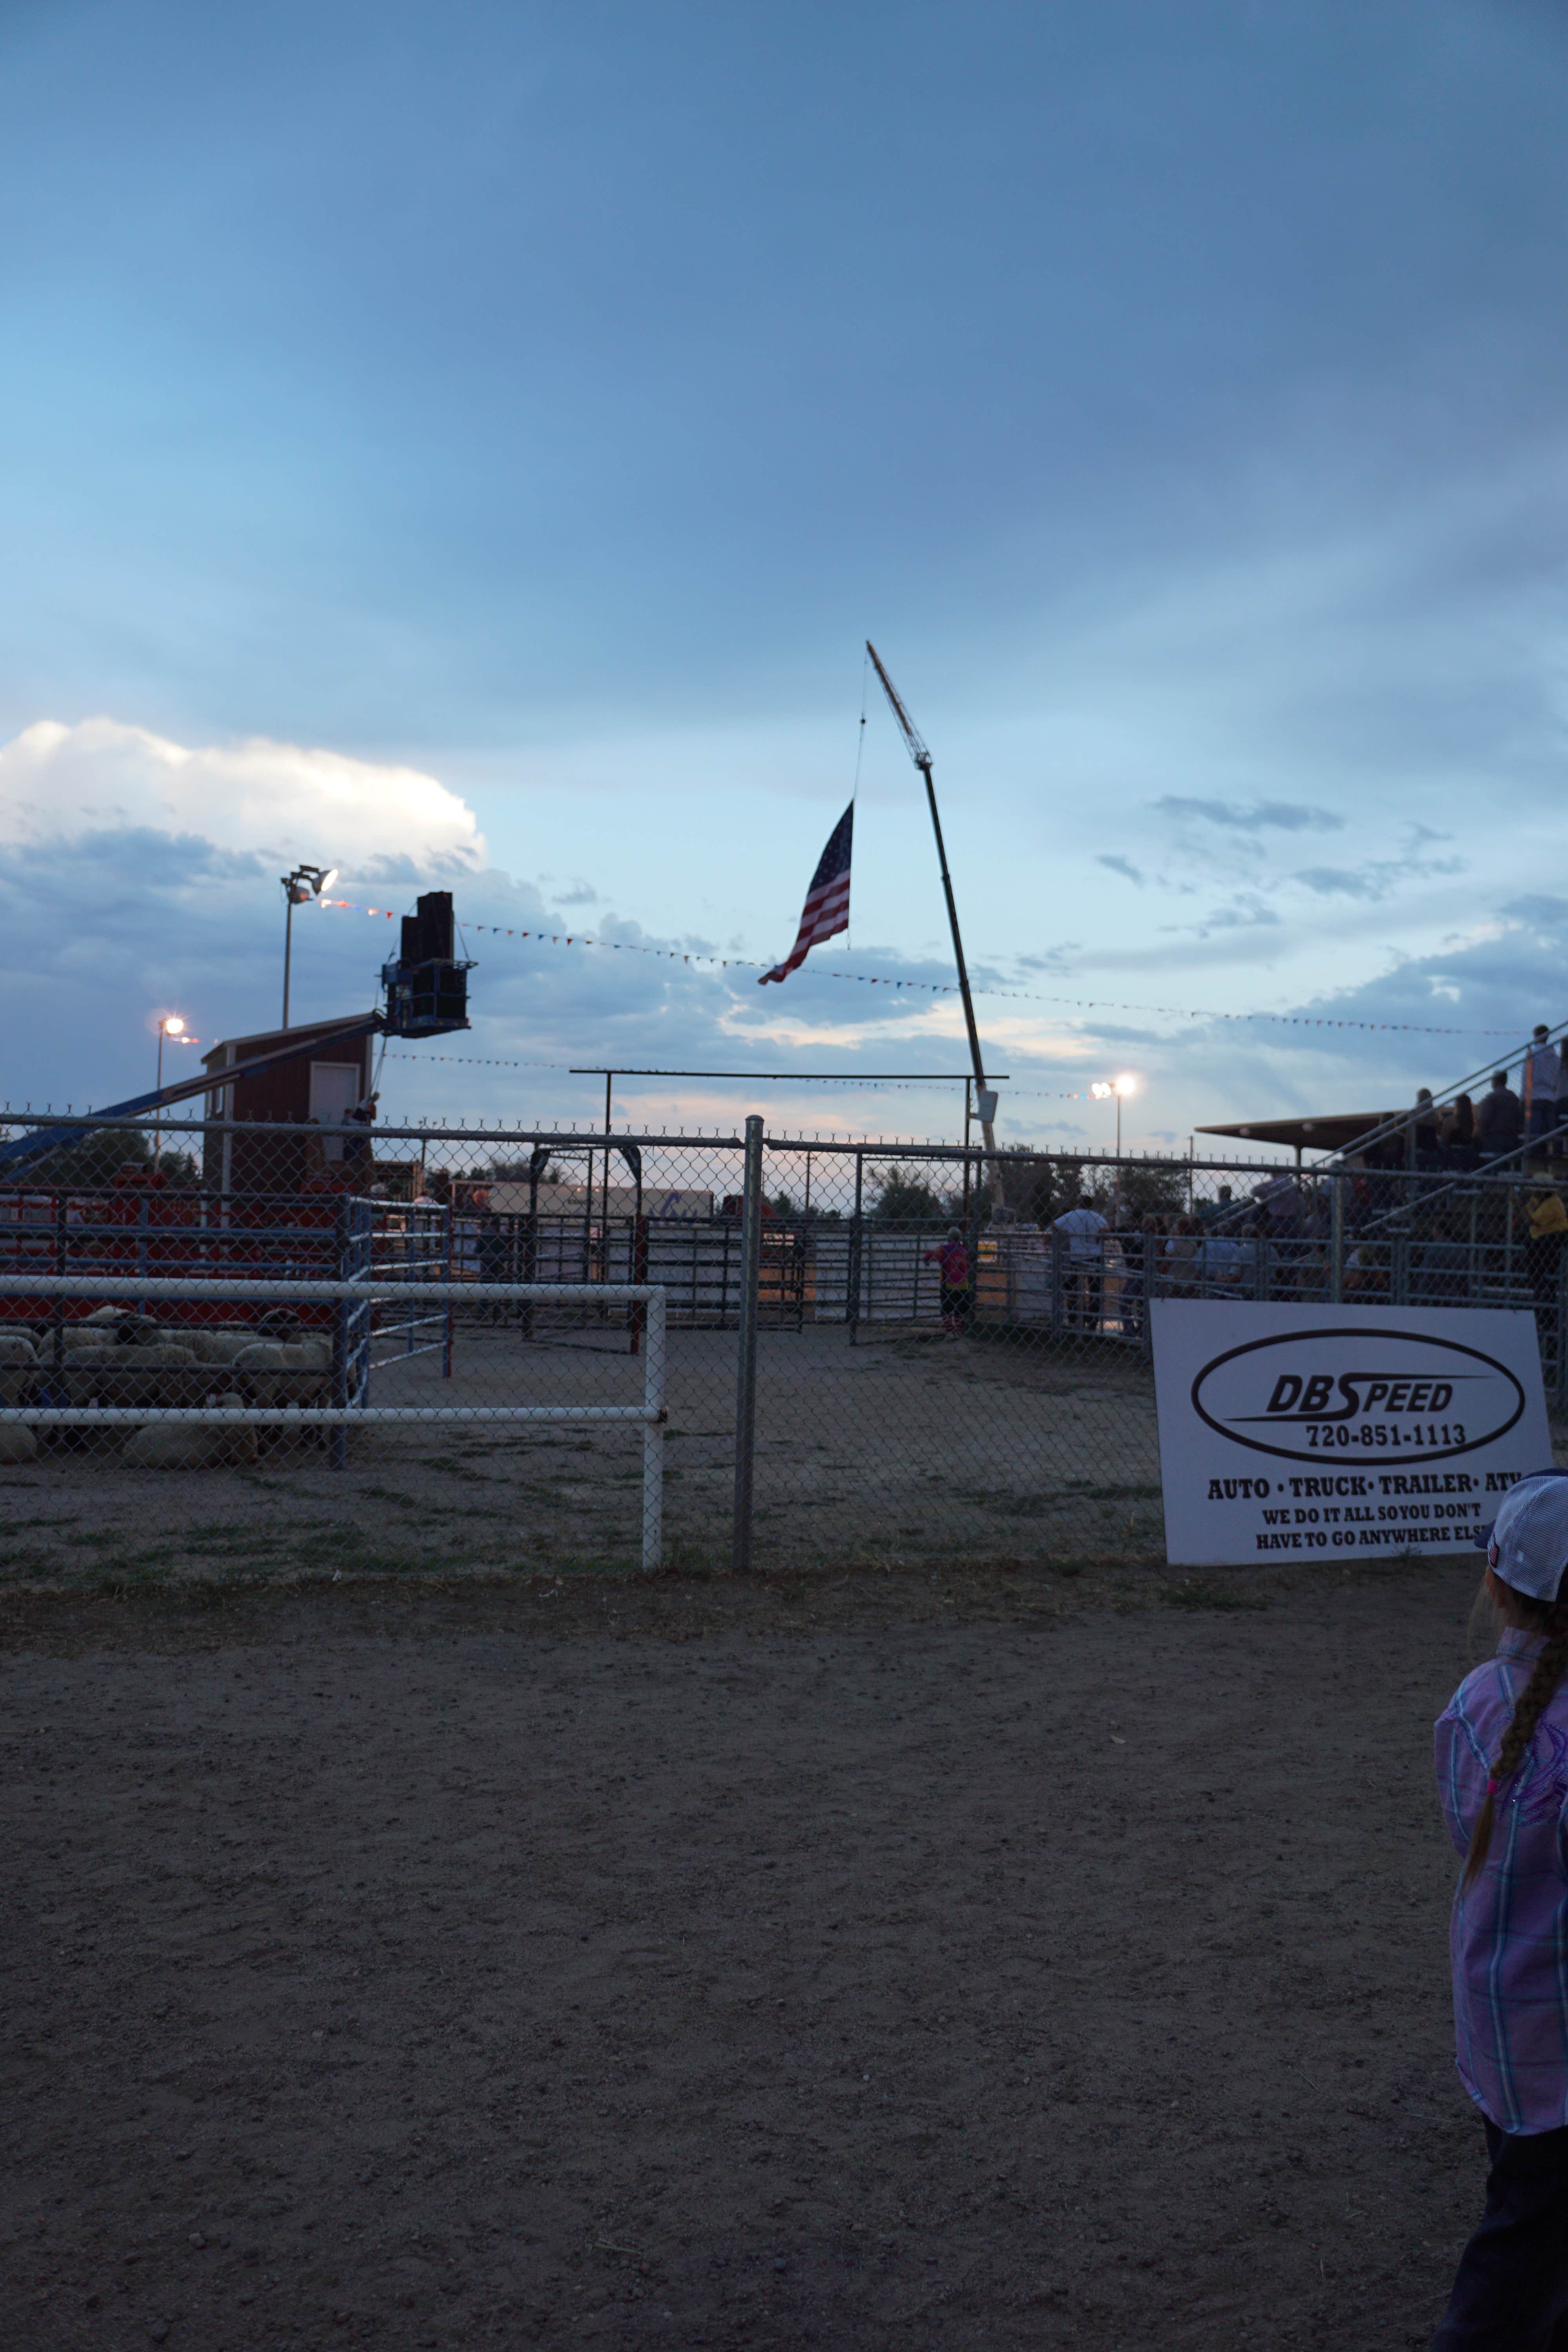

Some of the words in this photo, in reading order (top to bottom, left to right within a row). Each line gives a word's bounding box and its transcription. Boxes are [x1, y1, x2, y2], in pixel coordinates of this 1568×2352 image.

[1306, 1424, 1465, 1447] 720-851-1113
[1208, 1478, 1270, 1500] AUTO
[1289, 1476, 1367, 1497] TRUCK
[1379, 1474, 1472, 1495] TRAILER
[1261, 1509, 1290, 1525] WE
[1294, 1508, 1319, 1523] DO
[1323, 1508, 1340, 1523] IT
[1344, 1506, 1375, 1522] ALL
[1434, 1503, 1481, 1518] DON'T
[1256, 1533, 1302, 1550] HAVE
[1304, 1532, 1327, 1547] TO
[1332, 1531, 1356, 1546] GO
[1359, 1527, 1451, 1545] ANYWHERE
